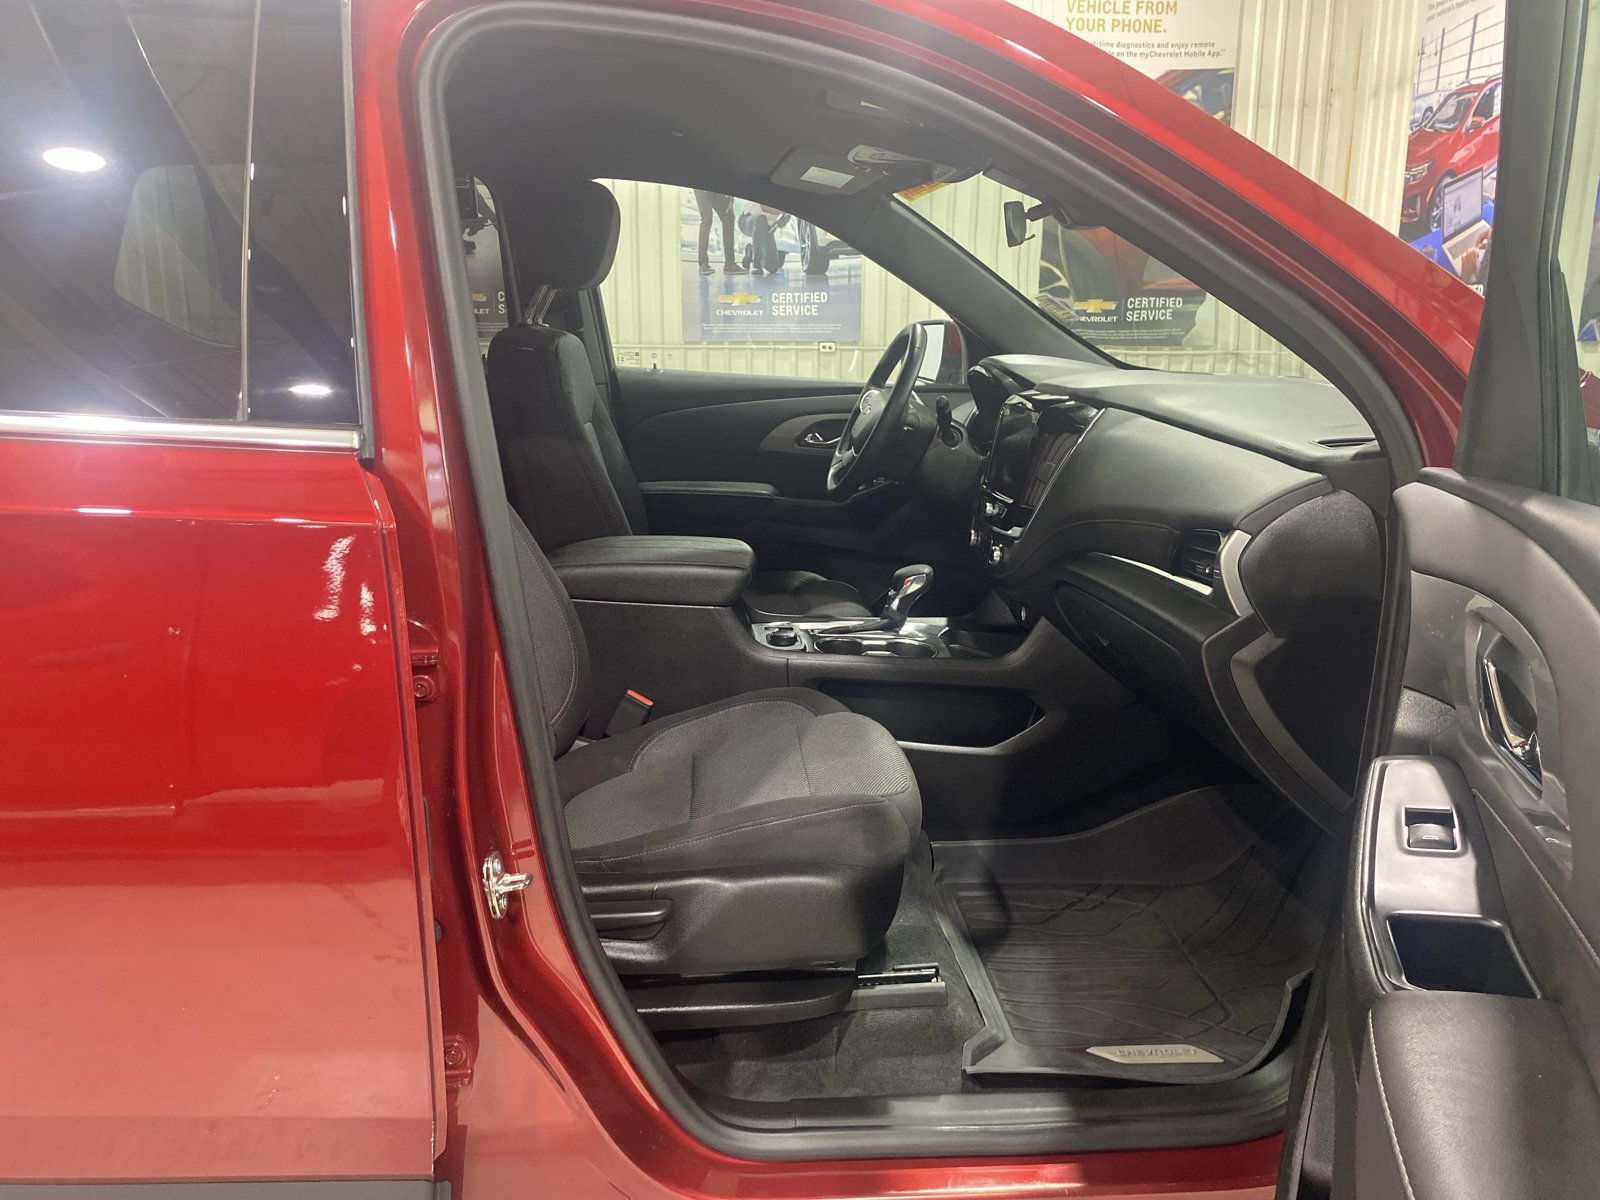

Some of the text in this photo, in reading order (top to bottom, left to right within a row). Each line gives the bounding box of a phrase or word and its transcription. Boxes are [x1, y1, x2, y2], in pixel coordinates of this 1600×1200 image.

[1066, 0, 1178, 15] VEHICLE FROM
[1066, 17, 1167, 33] YOUR PHONE.
[1116, 41, 1155, 50] diagnostics
[1171, 41, 1189, 50] enjoy
[1139, 50, 1182, 60] myChevrolet
[771, 292, 828, 304] CERTIFIED
[1127, 297, 1183, 309] CERTIFIED
[771, 304, 819, 316] SERVICE
[1126, 309, 1173, 322] SERVICE
